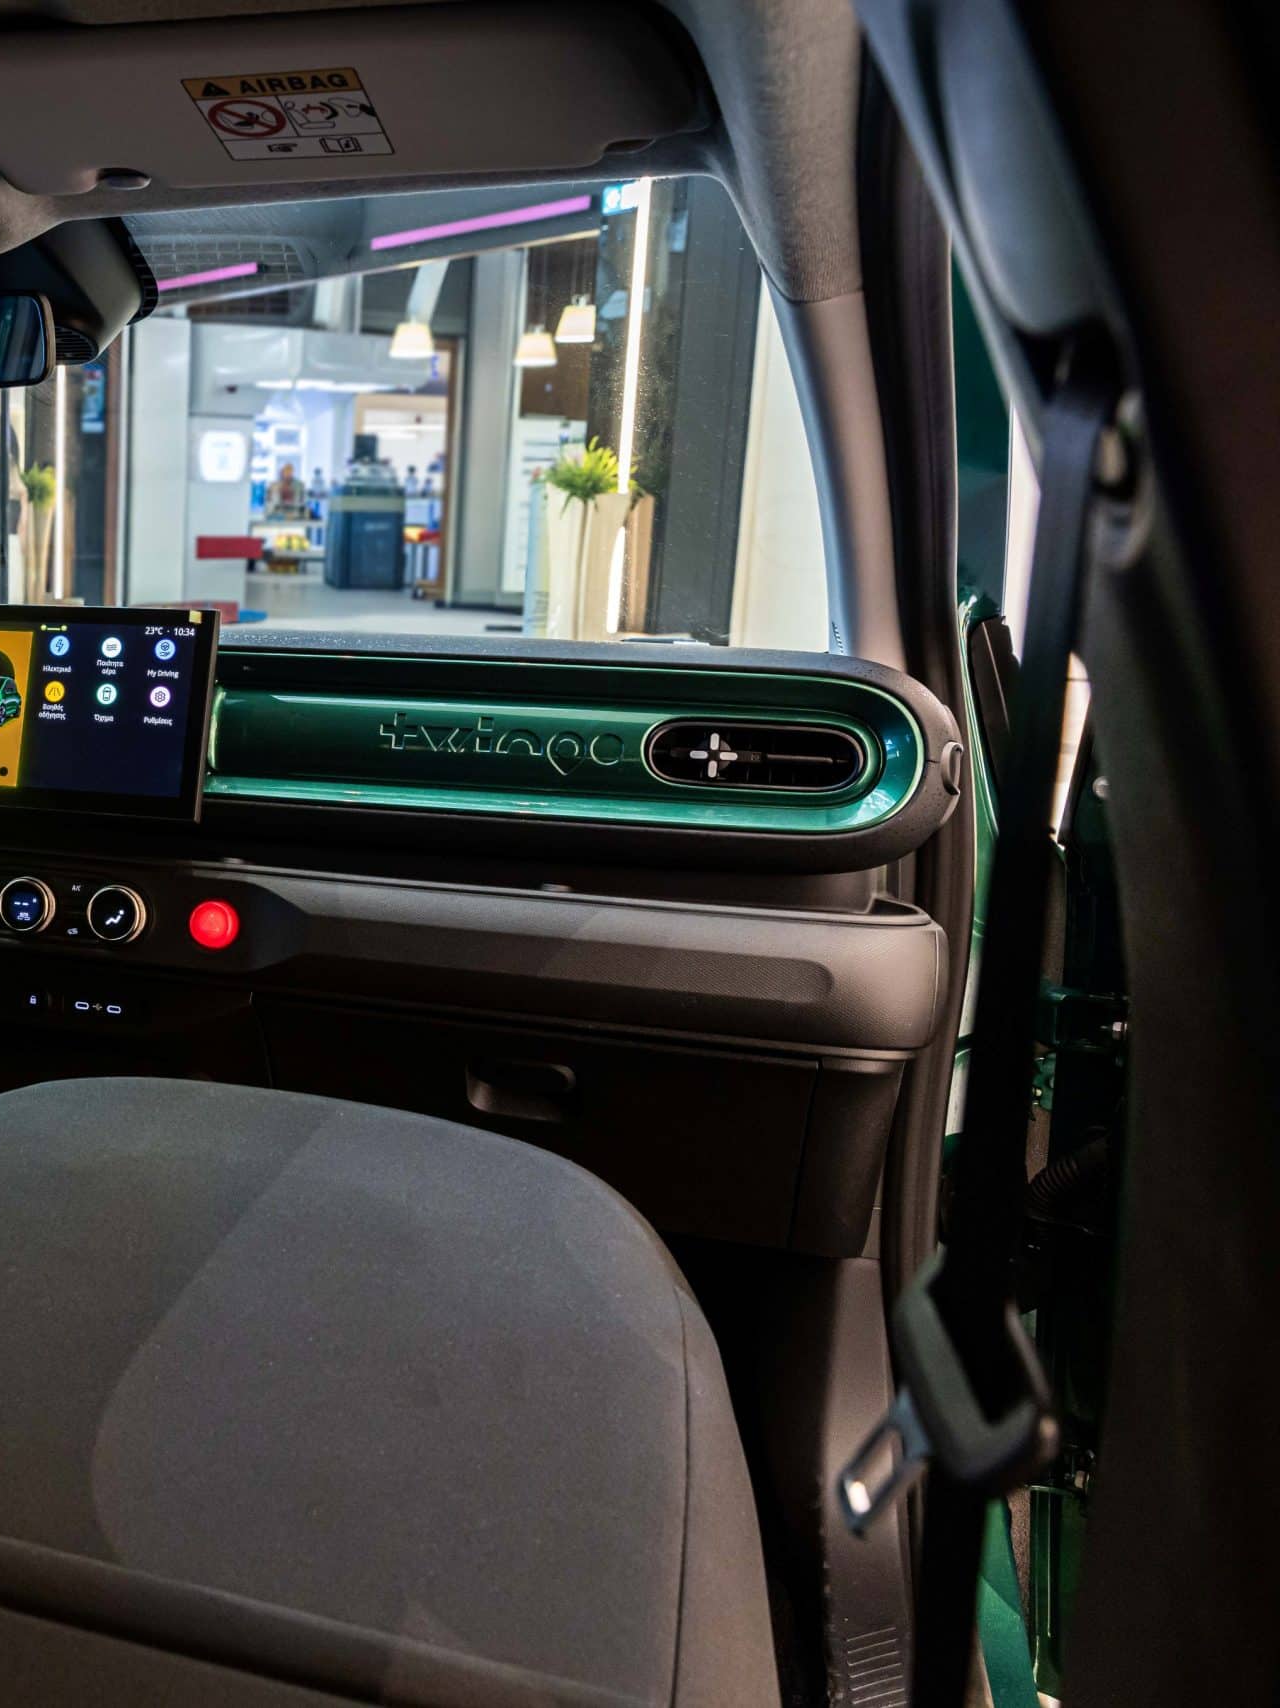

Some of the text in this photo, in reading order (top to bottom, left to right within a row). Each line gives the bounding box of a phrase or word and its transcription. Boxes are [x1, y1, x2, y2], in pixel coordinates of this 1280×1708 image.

[240, 74, 348, 93] AIRBAG
[145, 626, 196, 637] 23°C 10:34
[147, 669, 179, 678] My Driving
[379, 712, 626, 776] twingo
